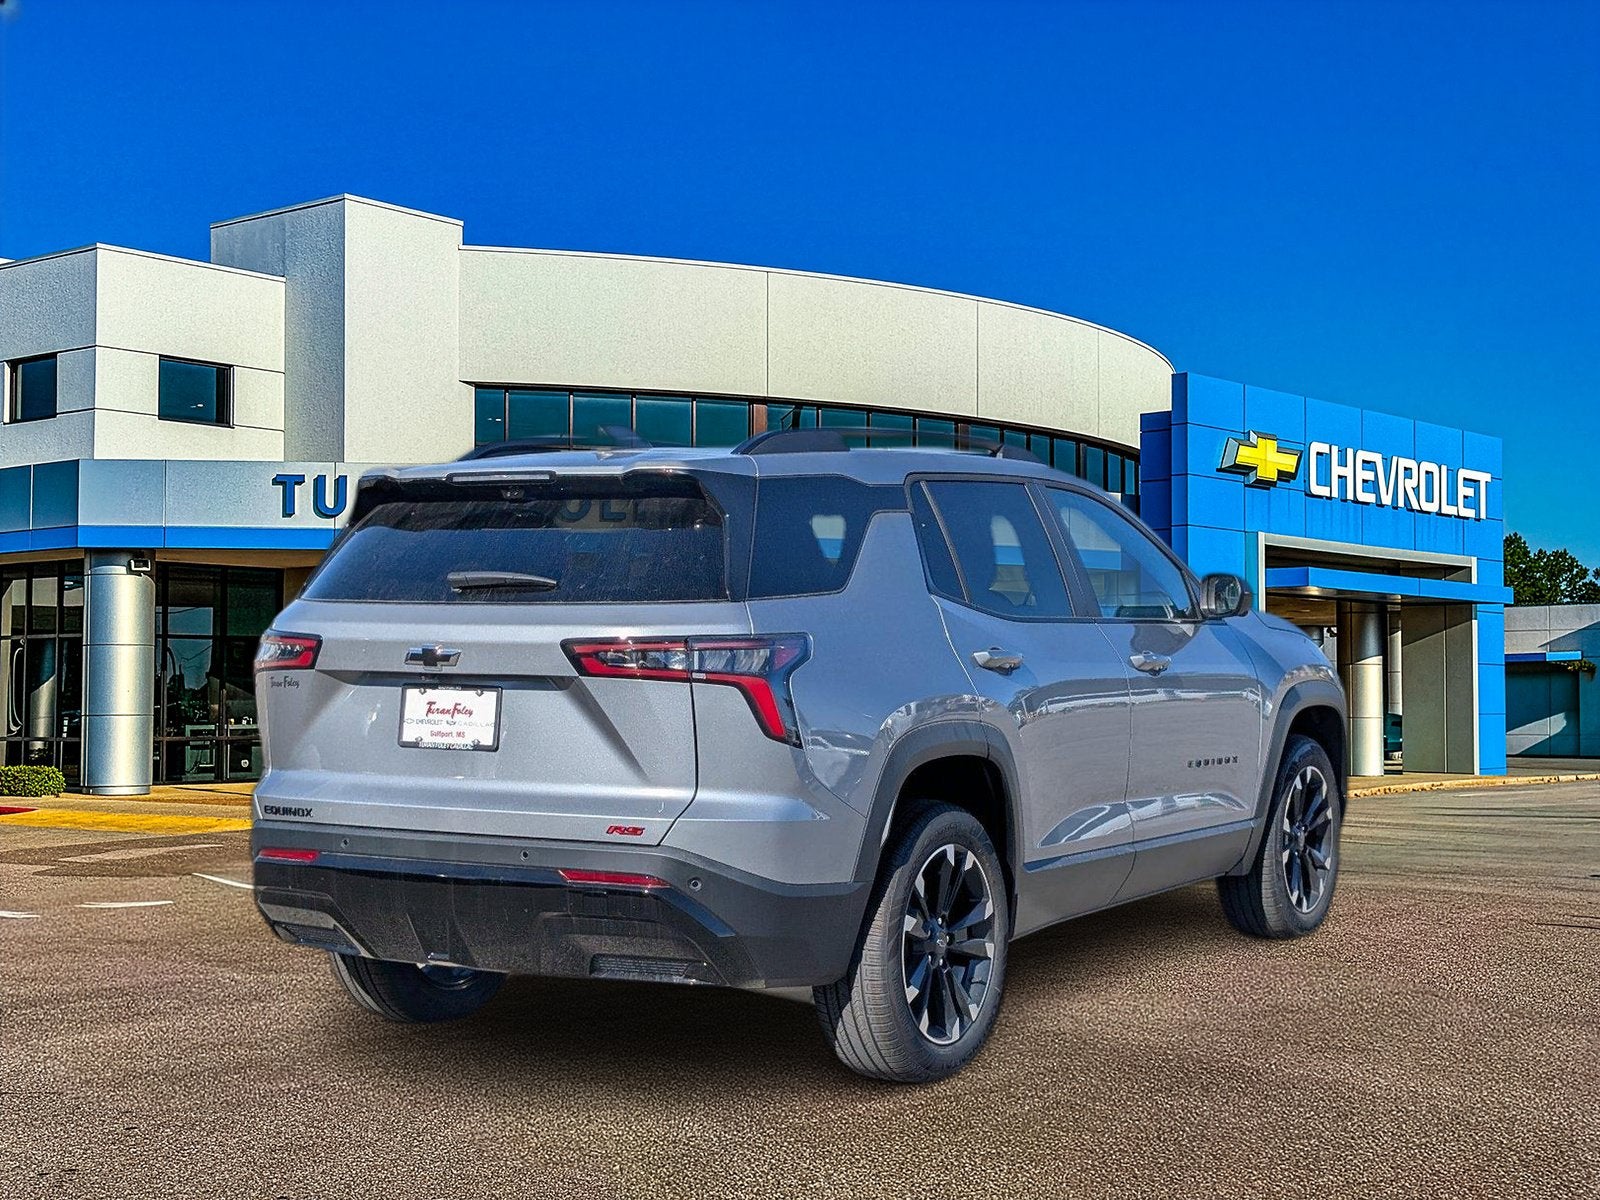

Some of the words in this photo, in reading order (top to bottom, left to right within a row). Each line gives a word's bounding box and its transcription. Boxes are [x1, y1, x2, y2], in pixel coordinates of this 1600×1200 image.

[1308, 441, 1491, 520] CHEVROLET
[451, 702, 474, 719] Foley
[416, 718, 443, 726] CHEVROLET
[264, 805, 313, 817] EQUINOX
[606, 825, 645, 836] RS
